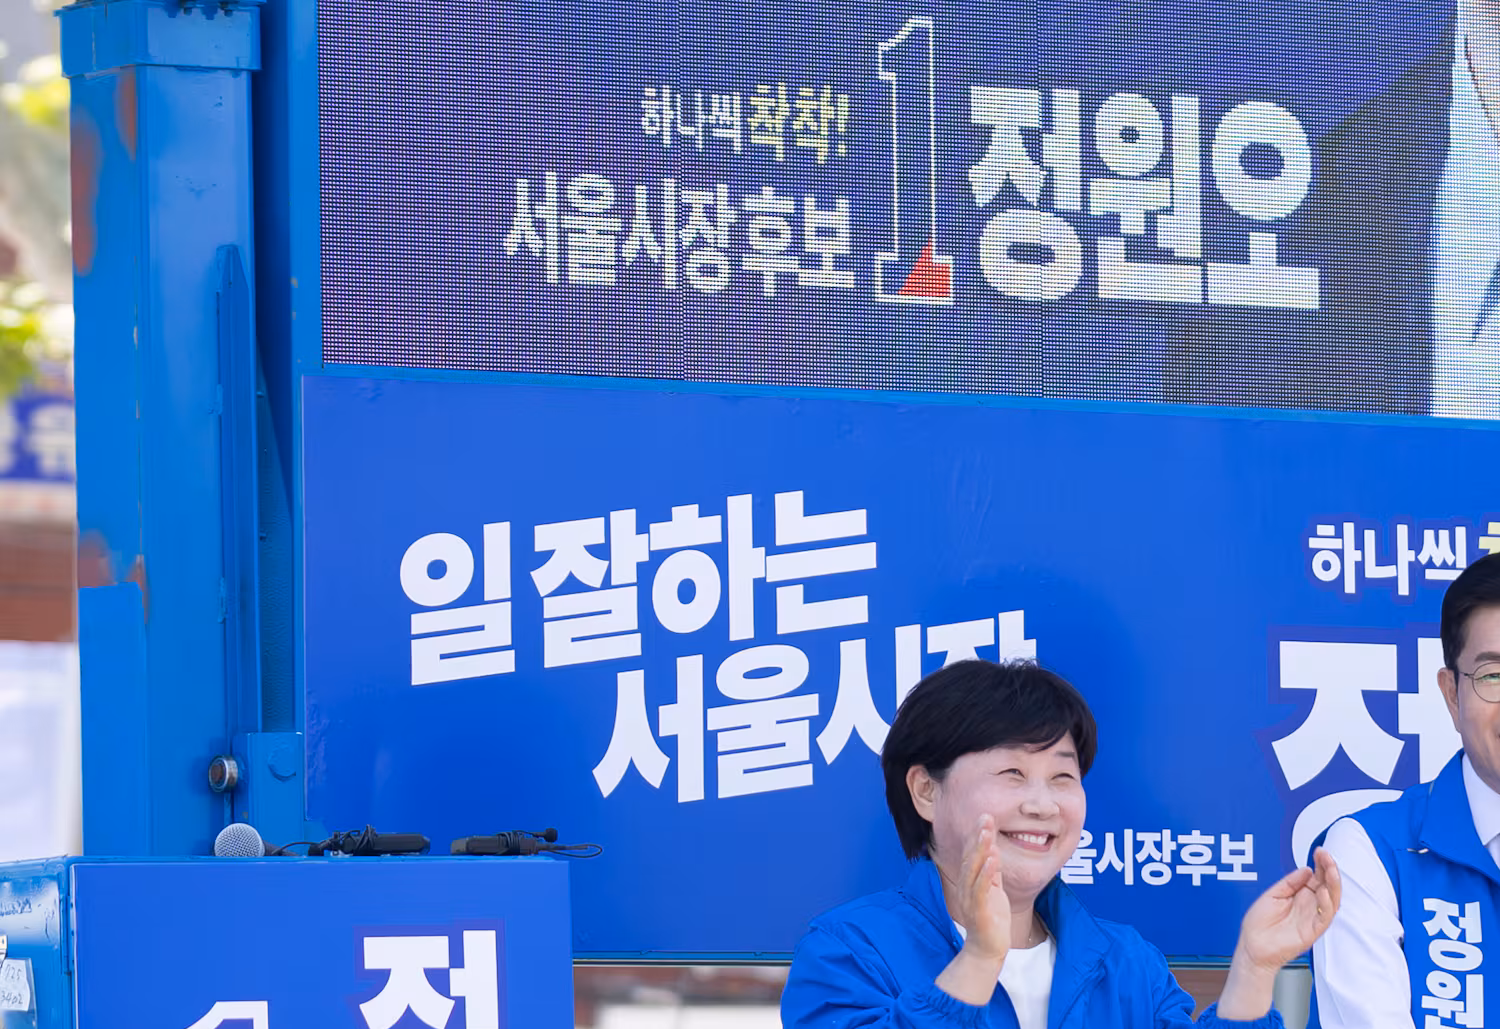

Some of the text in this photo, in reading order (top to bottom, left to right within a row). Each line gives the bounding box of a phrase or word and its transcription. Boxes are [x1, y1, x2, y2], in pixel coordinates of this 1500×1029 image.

[641, 82, 850, 165] 하나씩 착착!
[874, 15, 955, 306] 1
[503, 171, 855, 297] 서울시장후보
[968, 83, 1321, 310] 정원오
[400, 490, 878, 686] 일 잘하는
[1308, 521, 1467, 596] 하나씩
[1060, 828, 1258, 887] 울시장후보
